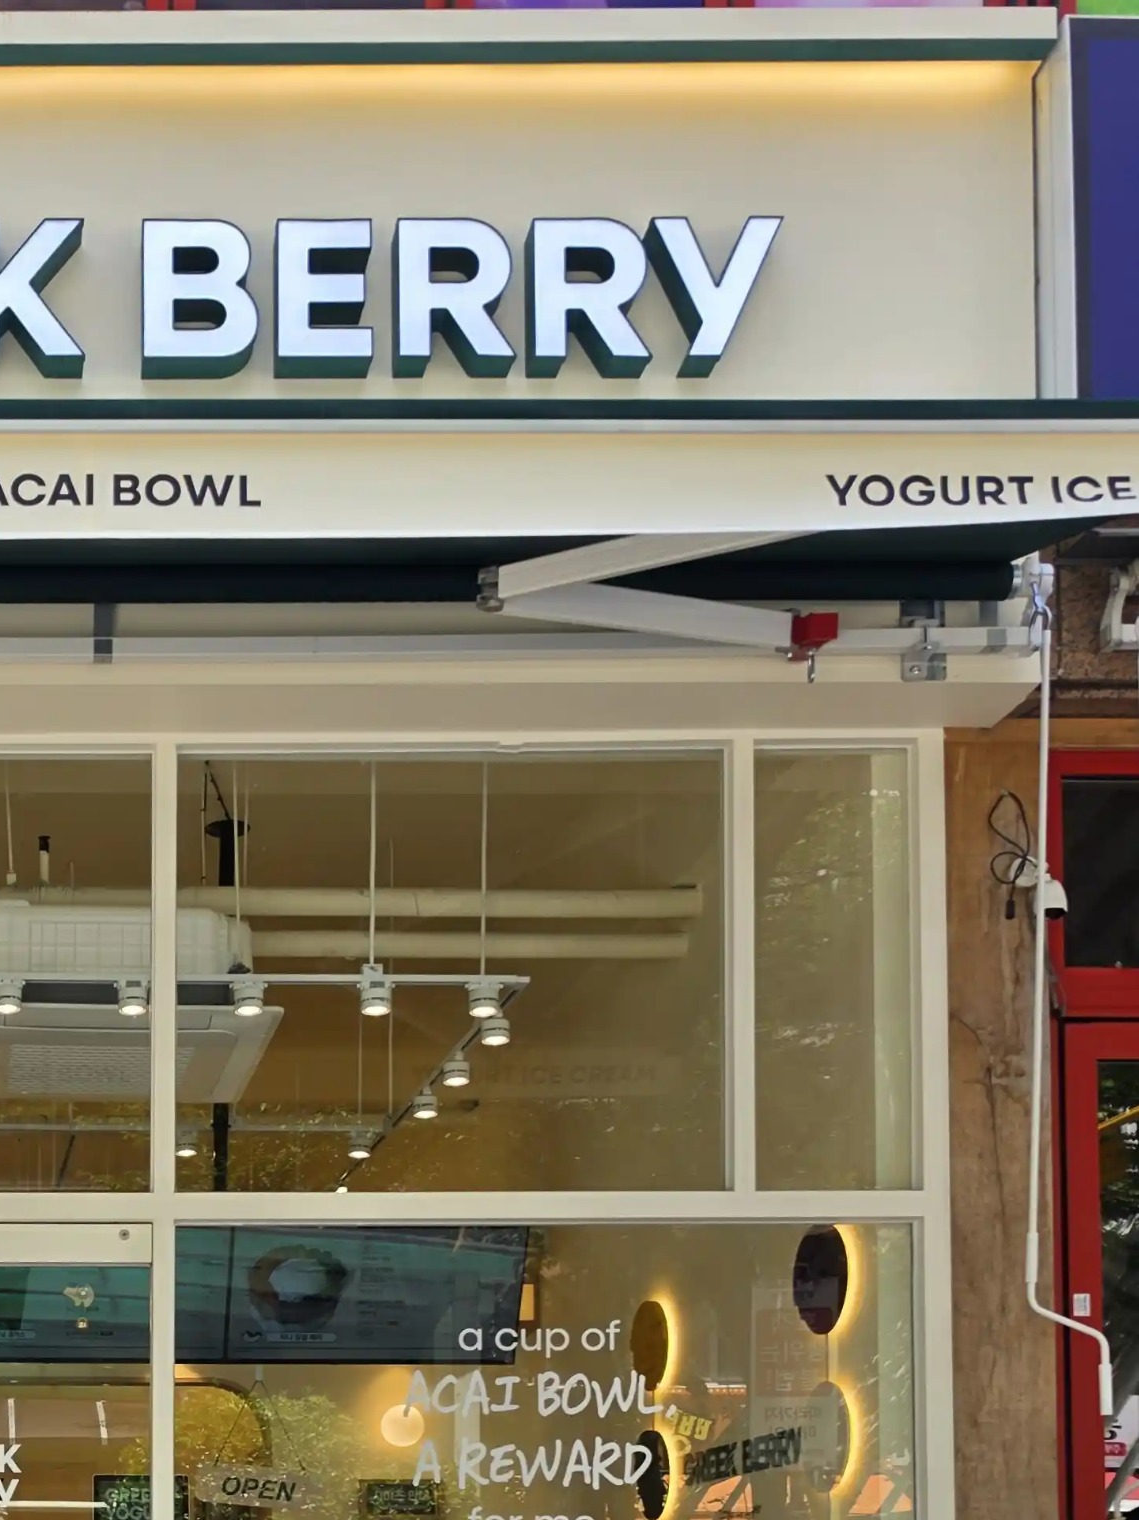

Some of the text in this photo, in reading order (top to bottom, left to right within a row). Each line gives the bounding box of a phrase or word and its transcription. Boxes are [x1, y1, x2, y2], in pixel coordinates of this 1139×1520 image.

[140, 216, 785, 380] BERRY
[113, 474, 262, 507] BOWL
[825, 474, 1137, 506] YOGURT ICE
[458, 1319, 621, 1359] a cup of
[403, 1369, 677, 1419] ACAI BOWL,
[412, 1436, 653, 1490] A REWARD
[742, 1426, 802, 1474] BERRY
[105, 1487, 151, 1502] GREE
[221, 1476, 297, 1502] OPEN
[106, 1503, 151, 1520] YOGU
